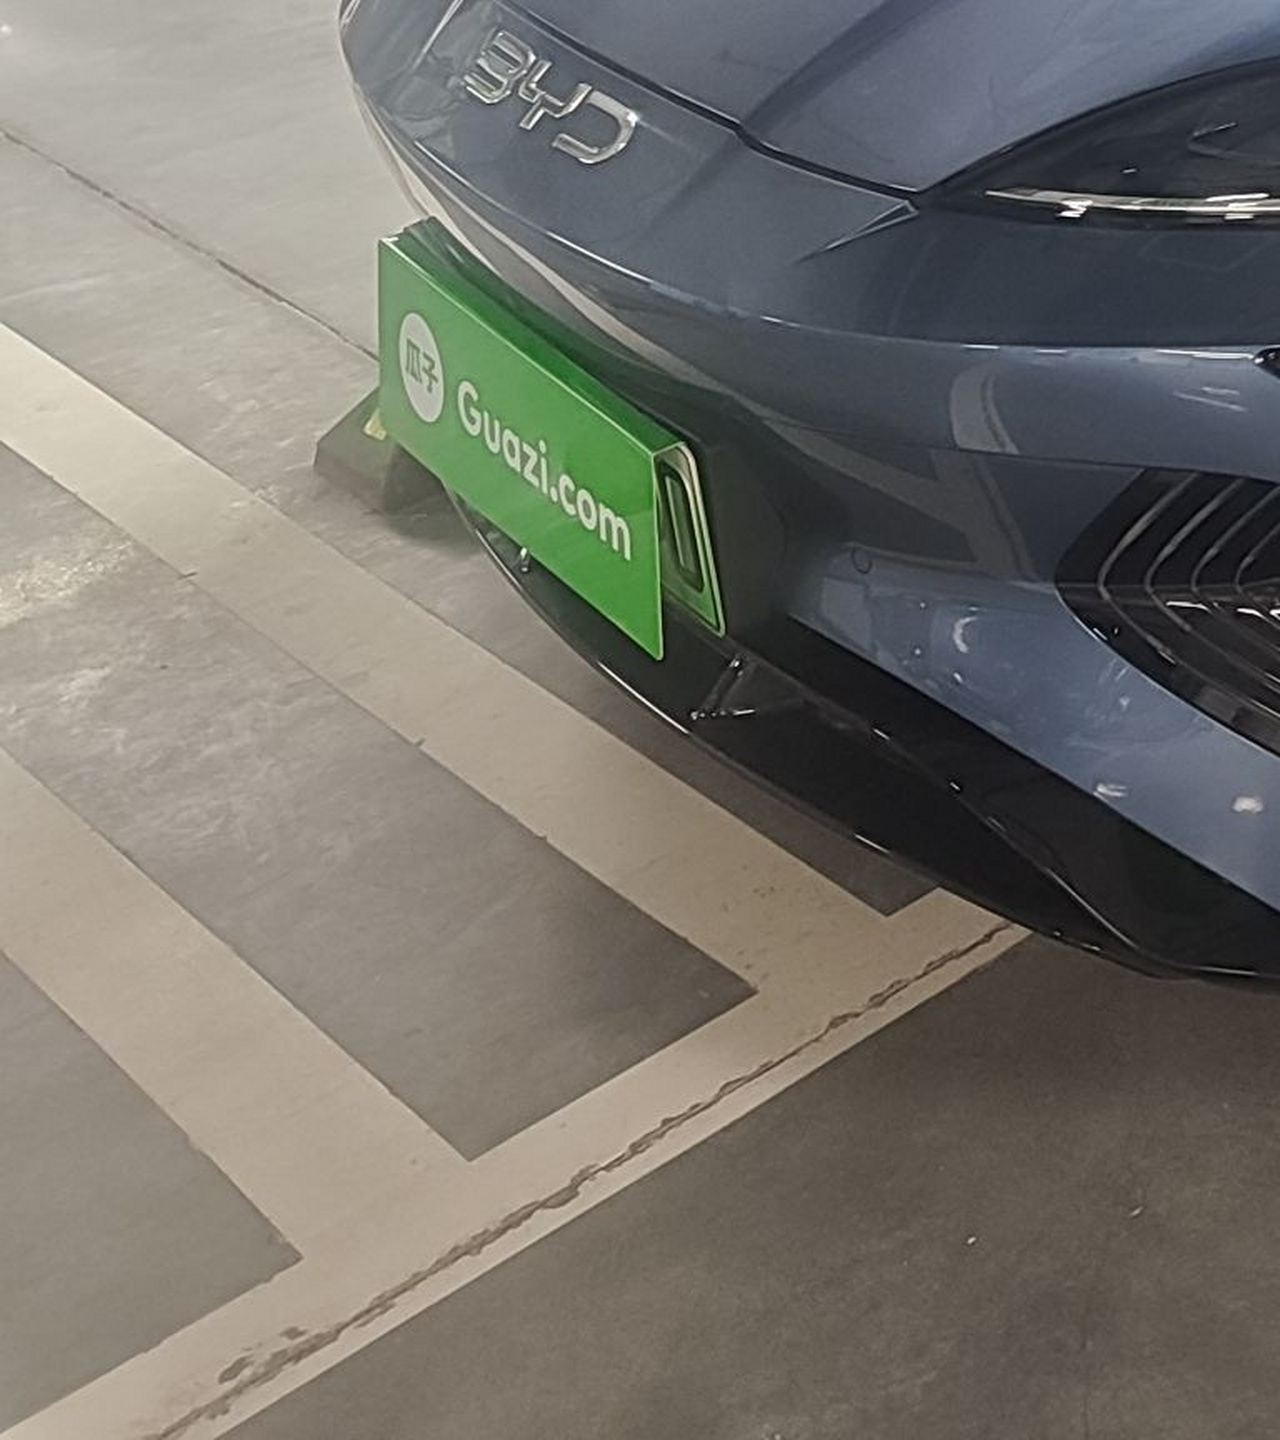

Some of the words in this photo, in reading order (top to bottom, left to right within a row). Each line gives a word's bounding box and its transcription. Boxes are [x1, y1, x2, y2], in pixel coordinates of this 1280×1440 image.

[462, 26, 641, 165] BYD
[405, 337, 440, 394] 瓜子
[457, 379, 632, 562] Guazi.com
